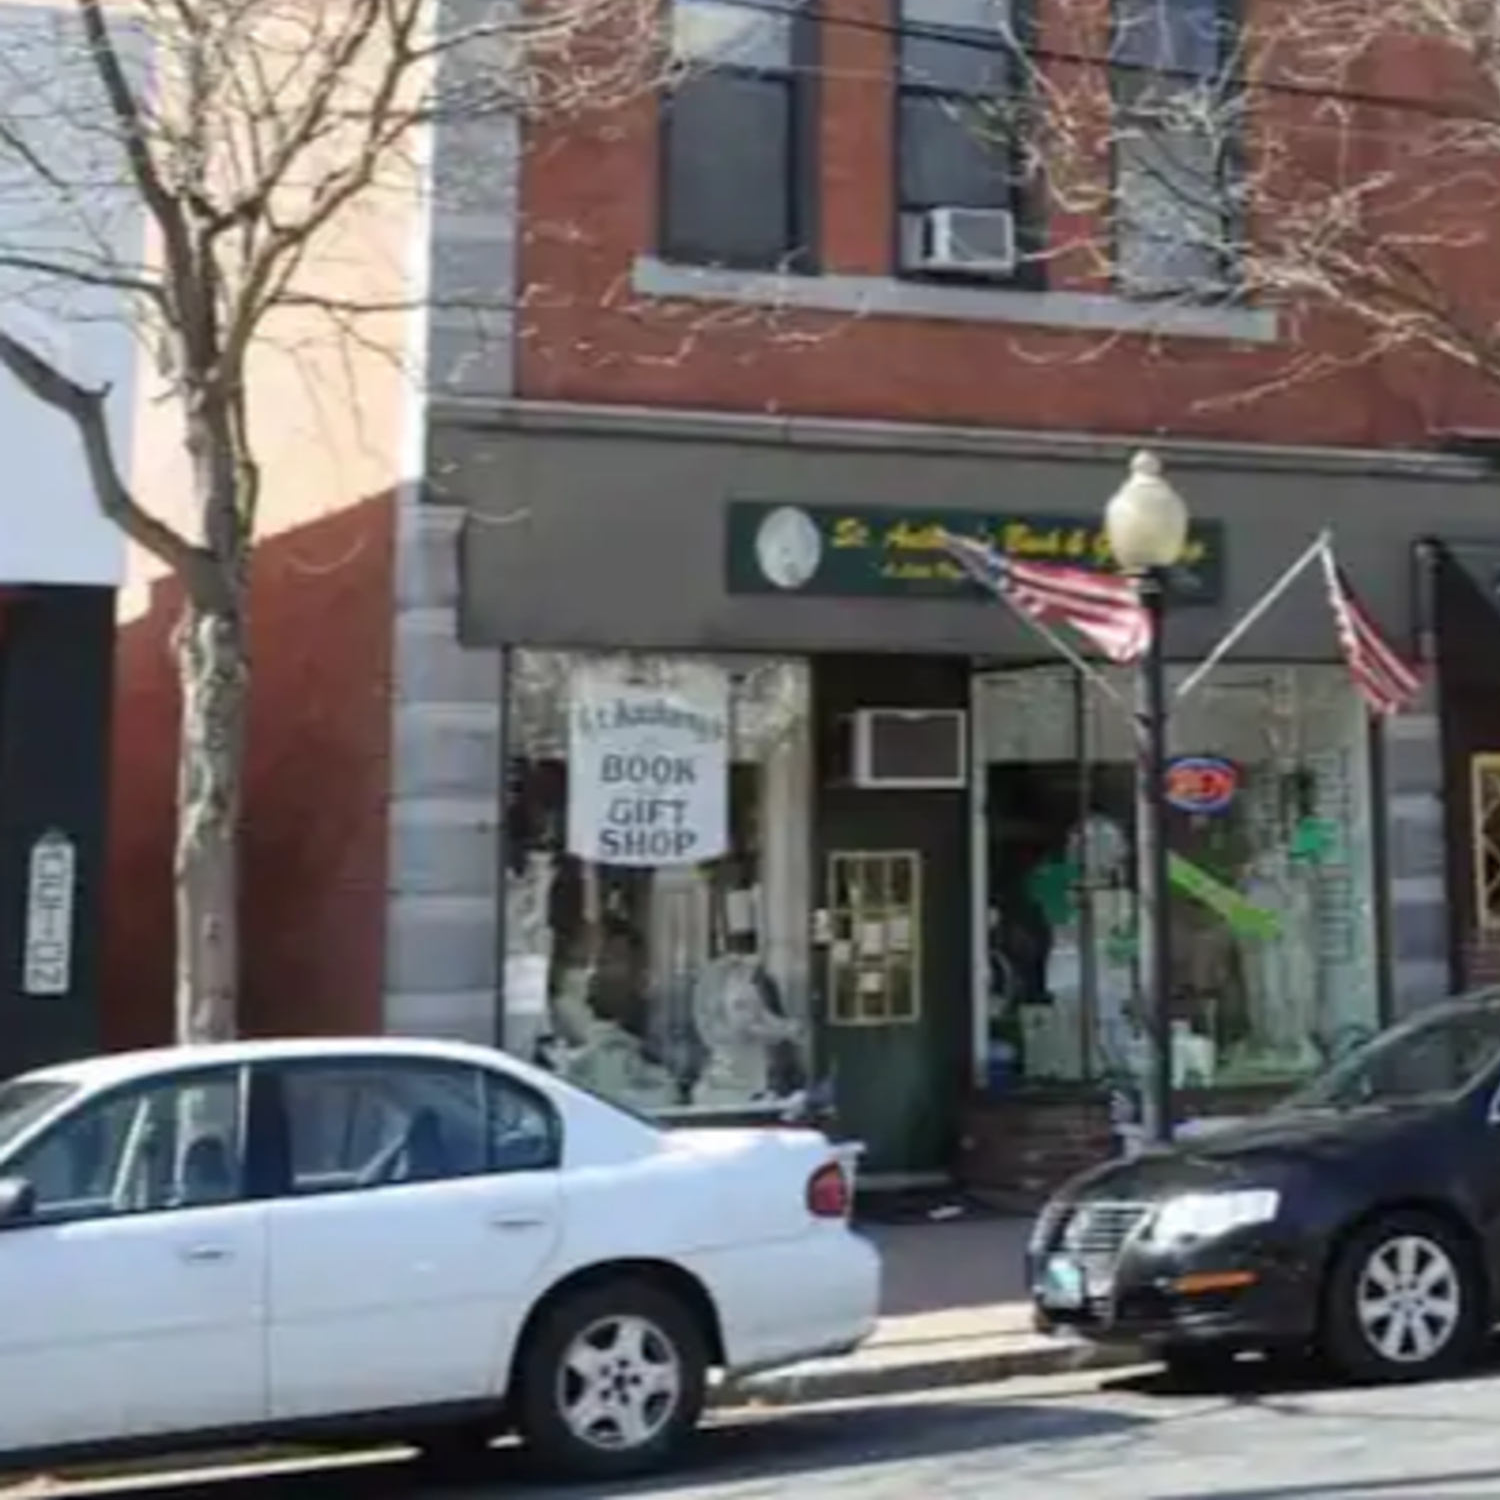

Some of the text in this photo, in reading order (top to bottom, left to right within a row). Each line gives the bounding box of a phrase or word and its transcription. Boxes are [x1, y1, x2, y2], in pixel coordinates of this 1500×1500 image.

[601, 753, 696, 785] BOOK
[606, 798, 688, 827] GIFT
[600, 828, 698, 858] SHOP
